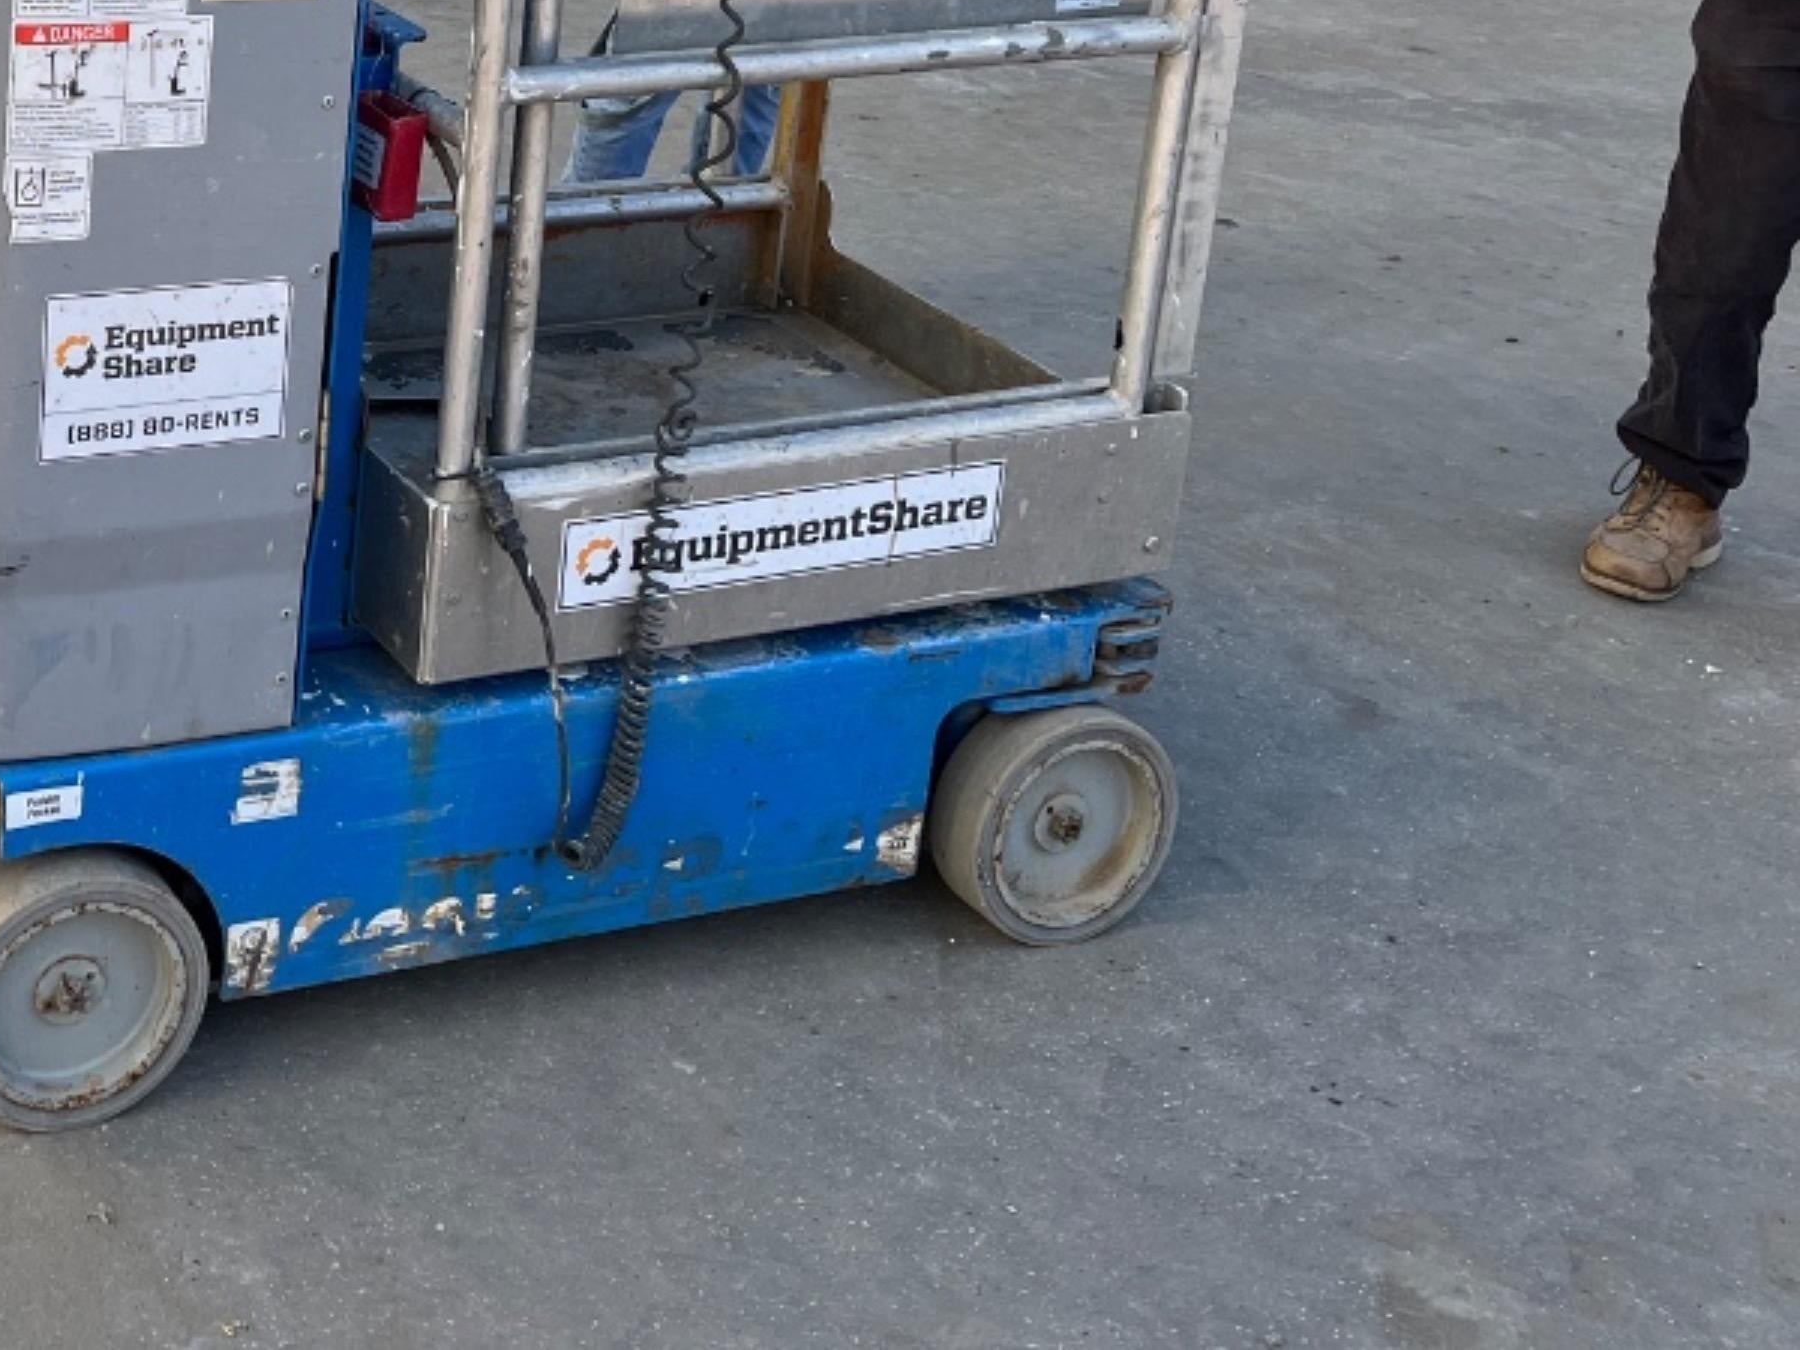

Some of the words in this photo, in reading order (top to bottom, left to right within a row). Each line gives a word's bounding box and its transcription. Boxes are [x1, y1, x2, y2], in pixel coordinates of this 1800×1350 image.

[104, 313, 280, 352] Equipment
[103, 352, 197, 379] Share
[629, 493, 988, 573] EquipmentShare
